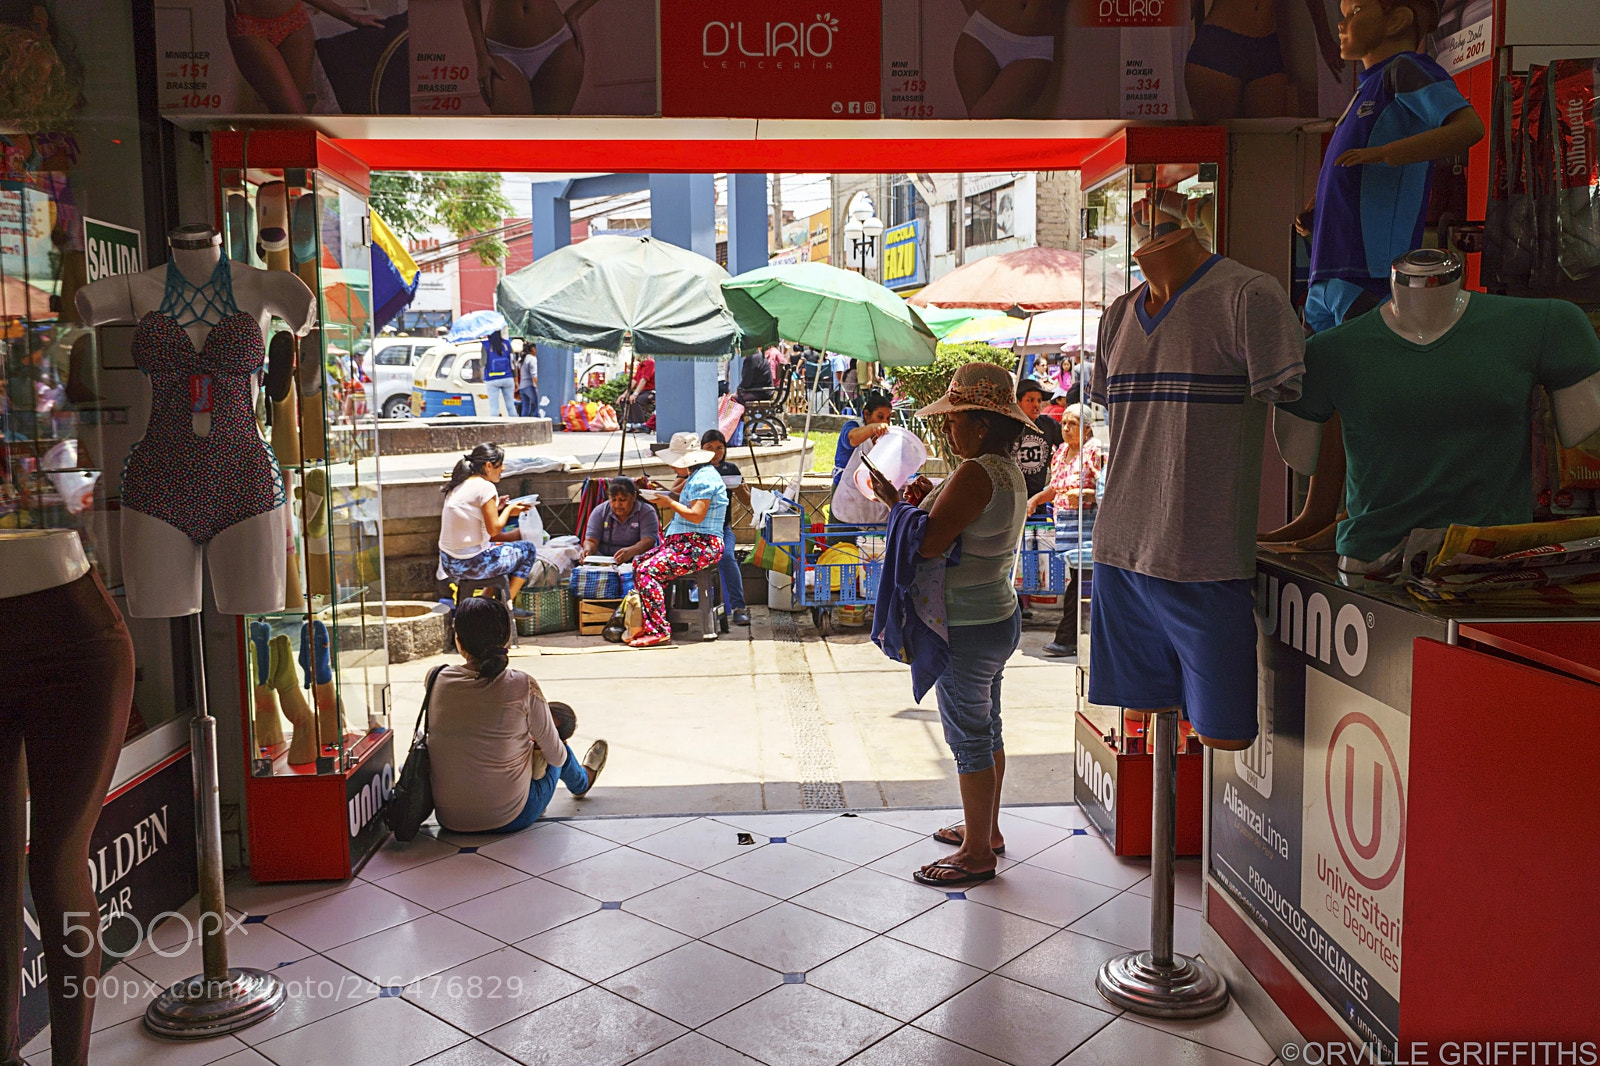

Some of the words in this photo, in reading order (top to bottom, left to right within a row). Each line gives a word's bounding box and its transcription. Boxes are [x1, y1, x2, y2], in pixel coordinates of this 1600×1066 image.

[703, 21, 832, 57] D'LIRIO
[1449, 34, 1465, 52] Baby
[165, 51, 210, 60] MINIBOXER
[1466, 40, 1486, 59] 2001
[417, 53, 446, 62] BIKINI
[181, 64, 209, 78] 151
[431, 66, 470, 80] 1150
[1126, 68, 1153, 76] BOXER
[166, 81, 208, 90] BRASSIER
[417, 84, 458, 92] BRASSIER
[903, 80, 927, 92] 153
[1136, 79, 1160, 90] 334
[181, 94, 222, 109] 1049
[431, 96, 462, 110] 240
[903, 105, 934, 117] 1153
[1137, 103, 1168, 115] 1333
[1567, 98, 1587, 177] Silhouette
[88, 237, 138, 281] SALIDA
[884, 242, 916, 281] FAZU
[1568, 466, 1600, 480] Silho
[1248, 865, 1307, 939] PRODUCTOS
[1309, 926, 1369, 1001] OFICIALES
[1325, 891, 1339, 919] de
[1343, 908, 1399, 974] Deportes
